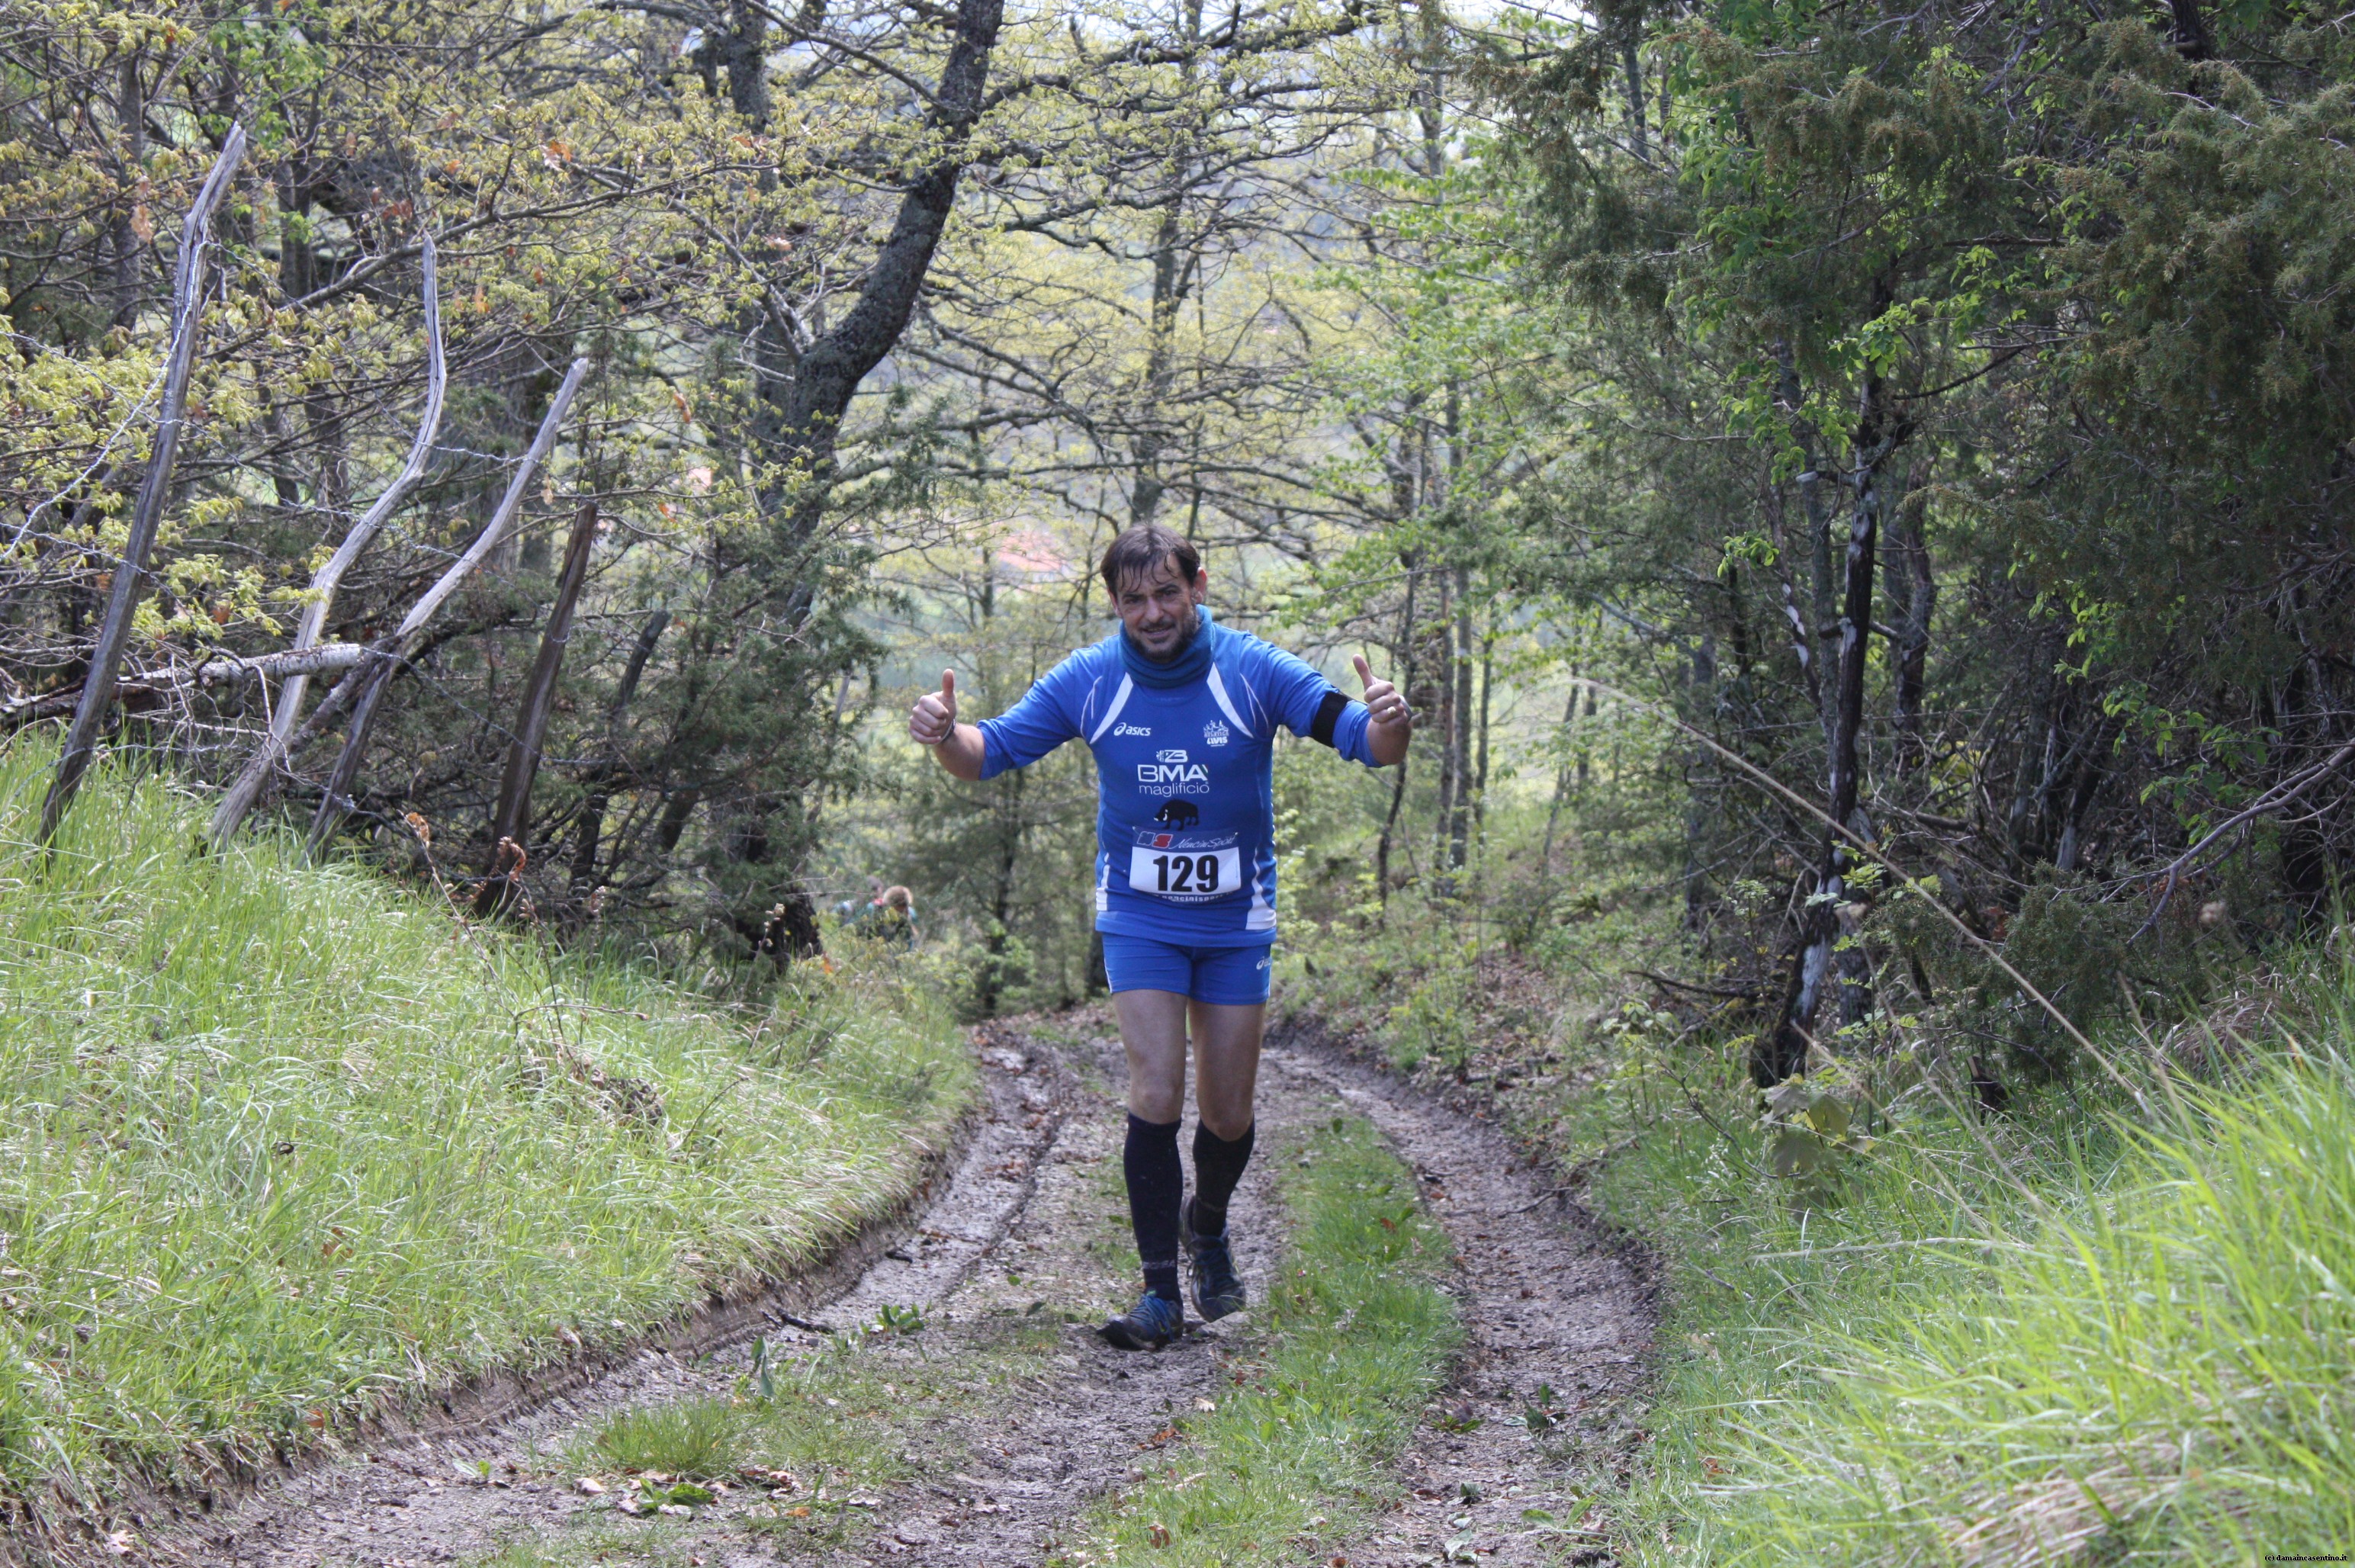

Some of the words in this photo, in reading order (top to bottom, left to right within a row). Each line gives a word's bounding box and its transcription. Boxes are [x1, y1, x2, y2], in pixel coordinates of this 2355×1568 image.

[1125, 725, 1152, 737] asics
[1137, 764, 1209, 782] BMA
[1139, 782, 1210, 798] maglificio
[1152, 854, 1219, 893] 129
